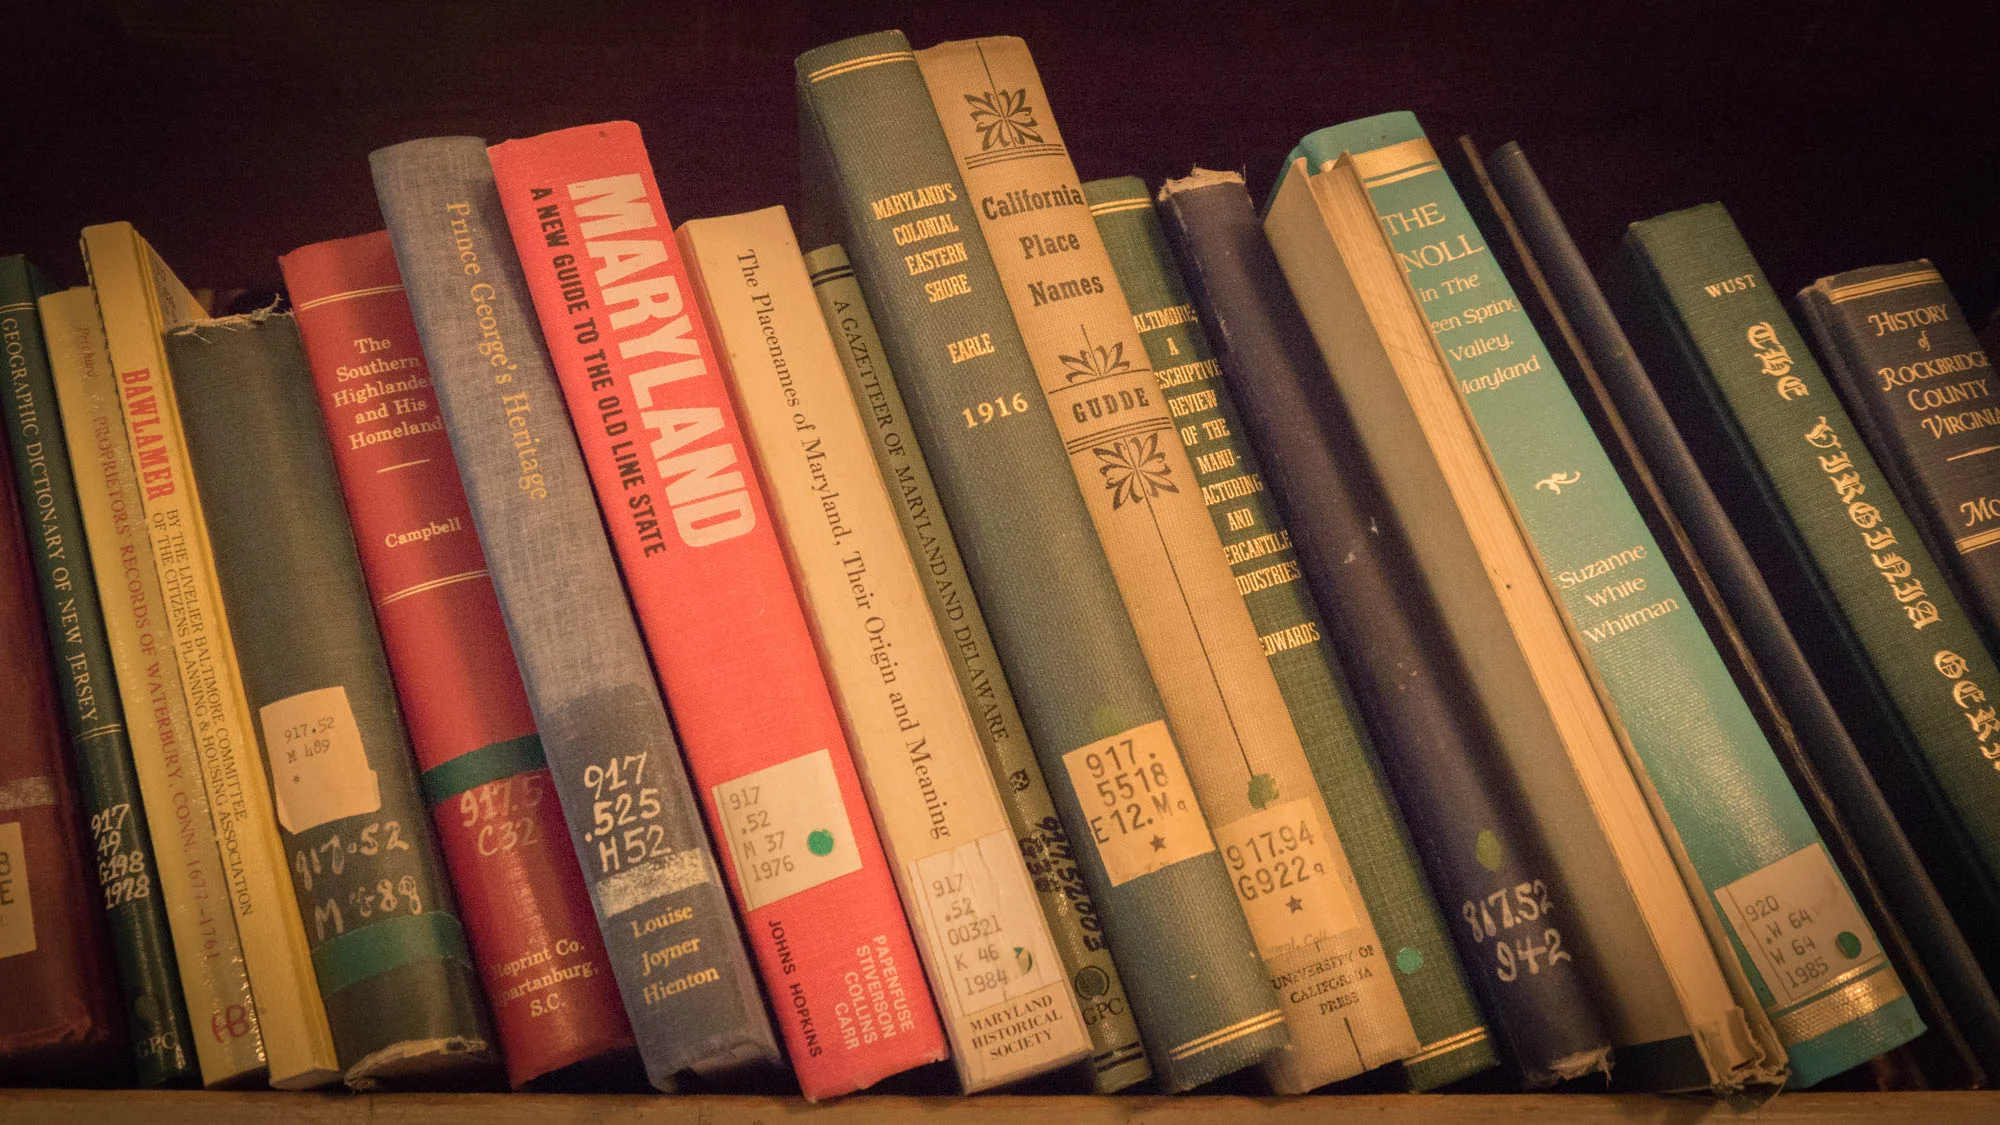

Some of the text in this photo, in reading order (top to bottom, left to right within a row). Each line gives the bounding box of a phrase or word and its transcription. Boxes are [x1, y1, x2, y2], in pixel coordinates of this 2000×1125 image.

[871, 182, 958, 220] MARYLAND'S
[981, 184, 1085, 221] California
[892, 213, 960, 247] COLONIAL
[1381, 202, 1447, 236] THE
[904, 241, 969, 276] EASTERN
[1018, 232, 1081, 260] Place
[1397, 234, 1485, 273] NOLL
[924, 273, 972, 303] SHORE
[1026, 275, 1105, 308] Names
[1419, 273, 1481, 303] in The
[1704, 274, 1757, 298] WUST
[1431, 315, 1463, 334] een
[1918, 330, 1931, 352] of
[354, 337, 391, 354] The
[446, 200, 547, 500] Prince George's Heritage
[567, 173, 756, 548] MARYLAND
[946, 333, 995, 364] EARLE
[1166, 338, 1179, 356] A
[336, 357, 420, 383] Southern
[531, 187, 666, 558] A NEW GUIDE TO THE OLD LINE STATE
[332, 375, 432, 408] Highlande
[1071, 386, 1150, 424] GUDDE
[1168, 389, 1217, 417] REVIEW
[355, 397, 427, 424] and His
[961, 392, 1030, 429] 1916
[122, 367, 176, 501] BAWLAMER
[348, 415, 443, 450] Homeland
[1181, 418, 1231, 446] OF THE
[1201, 472, 1264, 506] ACTURING
[1, 318, 98, 722] GEOGRAPHIC DICTIONARY OF NEW JERSEY
[384, 517, 462, 549] Campbell
[833, 300, 1010, 744] A GAZETTEER OF MARYLAND AND DELAWARE
[1226, 508, 1254, 532] AND
[736, 249, 951, 840] The Placenames of Maryland, Their Origin and Meaning
[1223, 530, 1293, 566] ERCANTILE
[1235, 560, 1301, 596] DUSTRIES
[1559, 545, 1648, 590] Suzanne
[120, 544, 150, 629] RECORDS
[139, 633, 157, 656] OF
[1585, 577, 1647, 609] White
[1583, 597, 1680, 643] Whitman
[166, 508, 248, 821] BY THE LIVELIER BALTIMORE COMMITTEE
[152, 512, 253, 917] OF THE CITIZENS PLANNING & HOUSING ASSOCIATION
[284, 717, 336, 743] 917.52
[287, 739, 331, 765] M 489
[583, 751, 647, 799] 917
[1096, 762, 1169, 807] 5518
[584, 788, 662, 842] .525
[729, 786, 760, 810] 917
[91, 803, 130, 840] 917
[743, 830, 785, 860] M 37
[1226, 820, 1315, 871] 917.94
[752, 855, 794, 882] 1976
[932, 873, 964, 898] 917
[105, 874, 150, 910] 1978
[1745, 895, 1780, 922] 920
[631, 905, 693, 938] Louise
[1788, 909, 1814, 930] 64
[555, 939, 585, 956] Co.
[642, 937, 701, 976] Joyner
[953, 943, 999, 972] K 46
[1769, 935, 1817, 966] W 64
[643, 967, 720, 1005] Hienton
[769, 920, 823, 1058] JOHNS HOPKINS
[872, 934, 915, 1033] PAPENFUSE
[963, 968, 1009, 996] 1984
[1785, 956, 1829, 989] 1985
[530, 993, 567, 1018] S.C.
[844, 971, 878, 1045] COLLINS
[856, 944, 896, 1040] STIVERSON
[1319, 992, 1360, 1016] PRESS
[835, 1002, 860, 1051] CARR
[969, 994, 1054, 1033] MARYLAND
[1083, 997, 1124, 1025] GPC
[971, 1009, 1063, 1050] HISTORICAL
[989, 1029, 1053, 1060] SOCIETY
